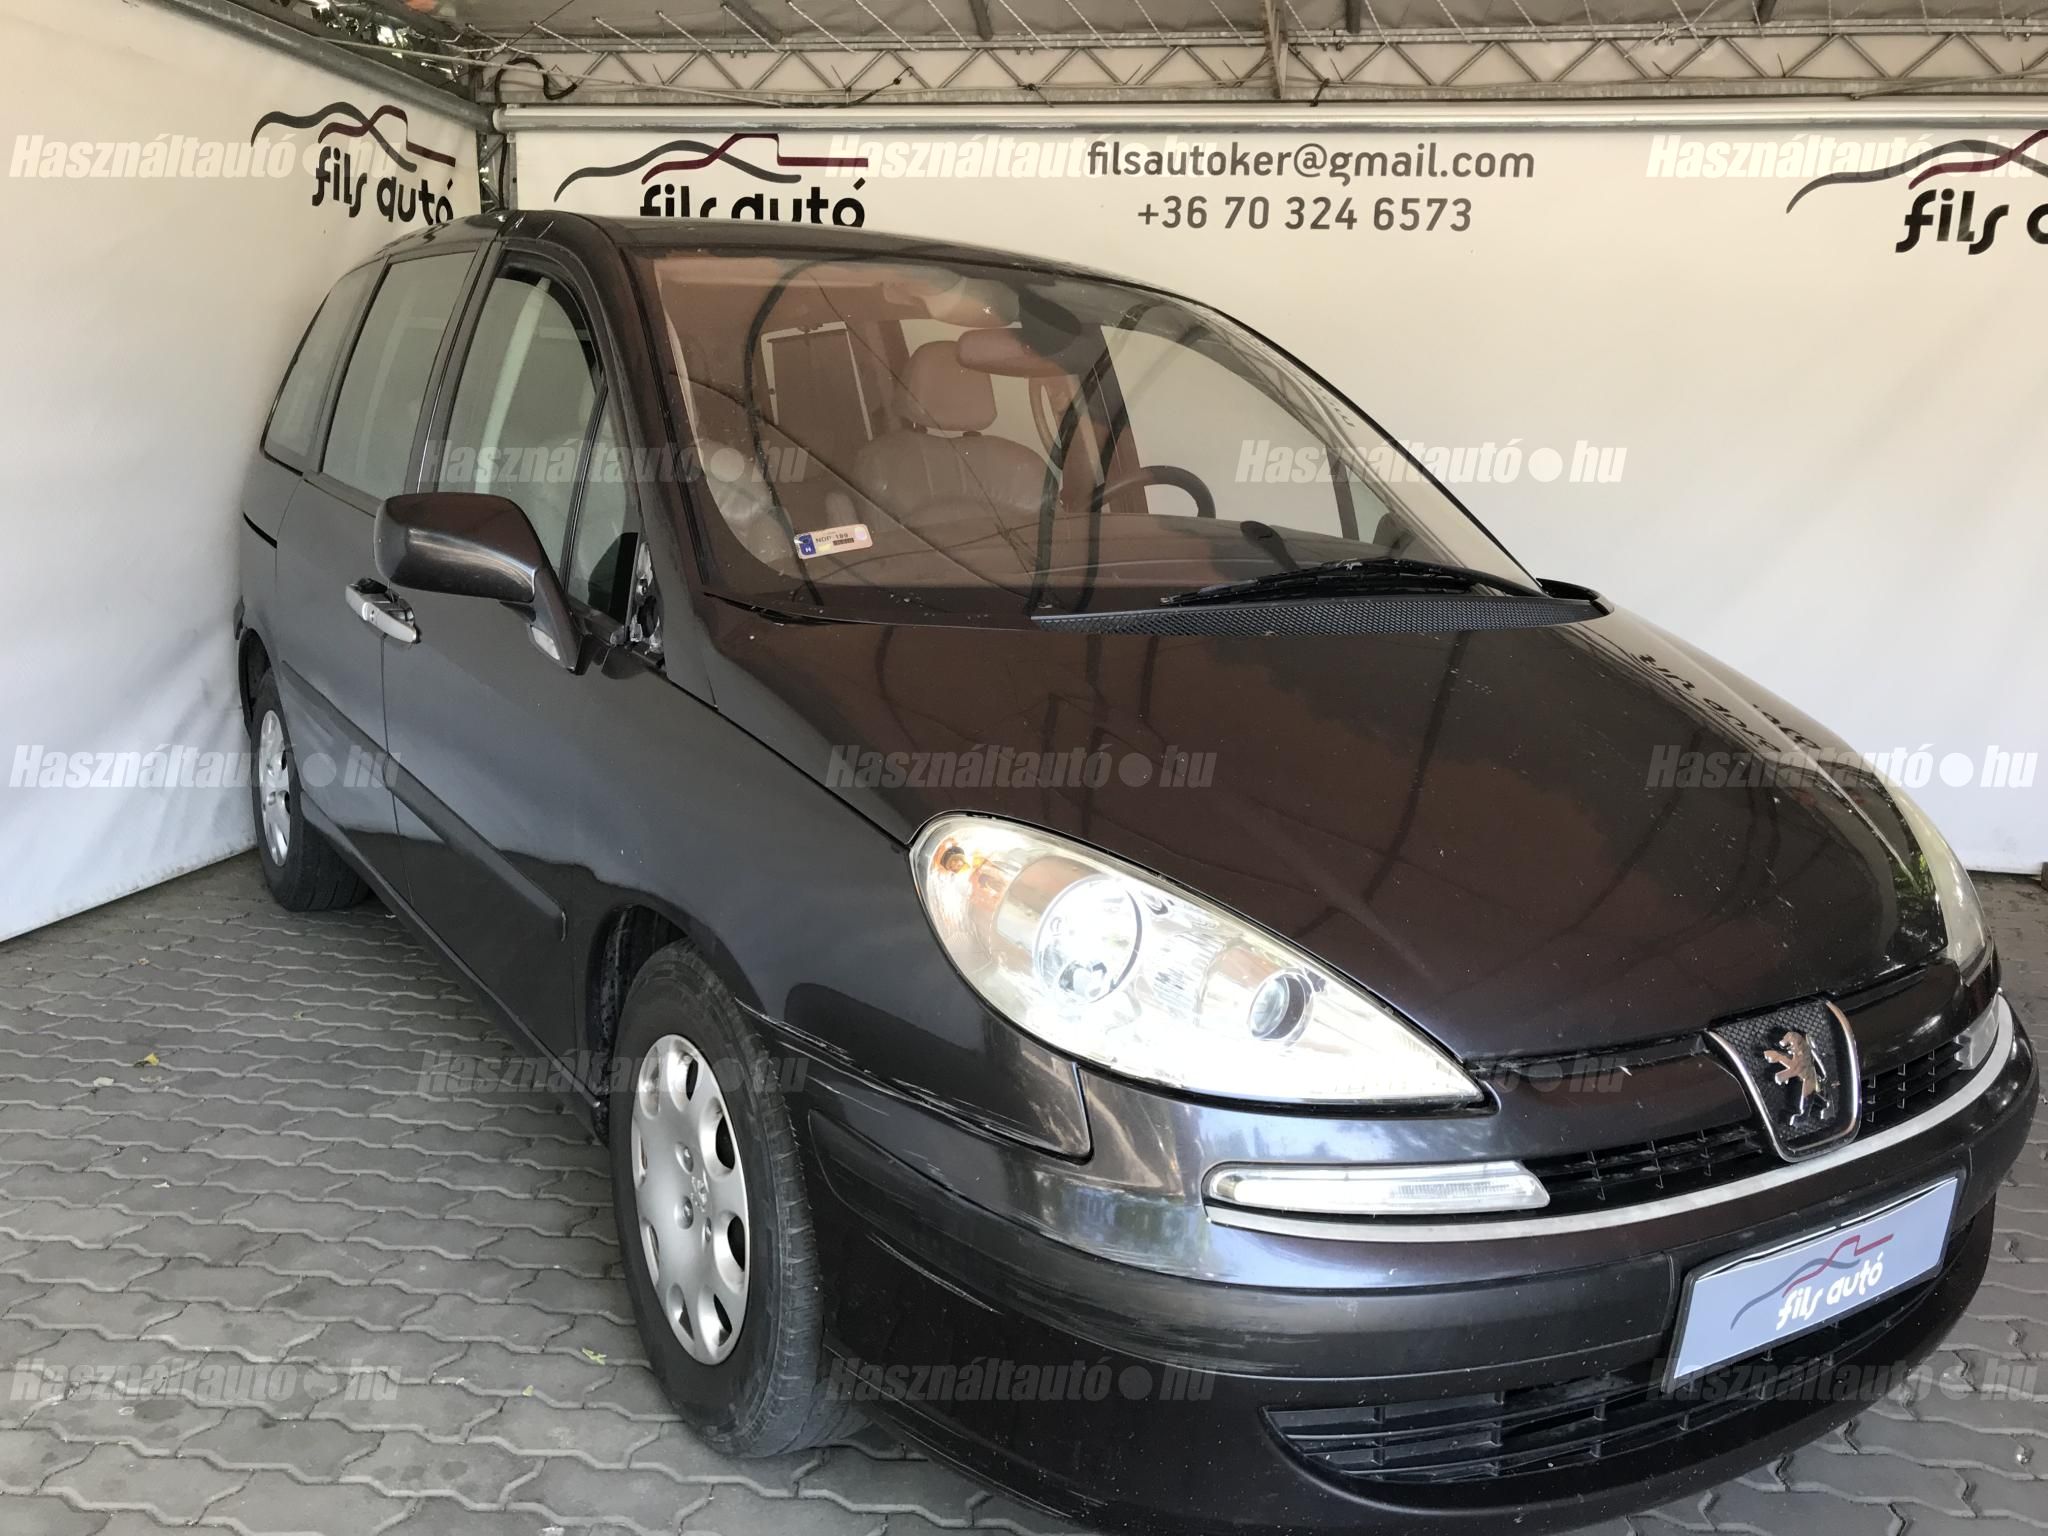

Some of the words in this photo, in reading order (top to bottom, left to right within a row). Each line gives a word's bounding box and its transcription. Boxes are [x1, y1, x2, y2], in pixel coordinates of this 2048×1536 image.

[312, 146, 367, 217] fils
[377, 176, 454, 226] autó
[1087, 141, 1535, 186] filsautoker@gmail.com
[731, 177, 865, 228] autó
[1138, 195, 1207, 229] +36
[1224, 196, 1270, 229] 70
[1284, 196, 1358, 230] 324
[1372, 197, 1473, 232] 6573
[1895, 187, 2009, 255] fils
[1776, 1286, 1824, 1331] fils
[1826, 1251, 1884, 1305] autó
